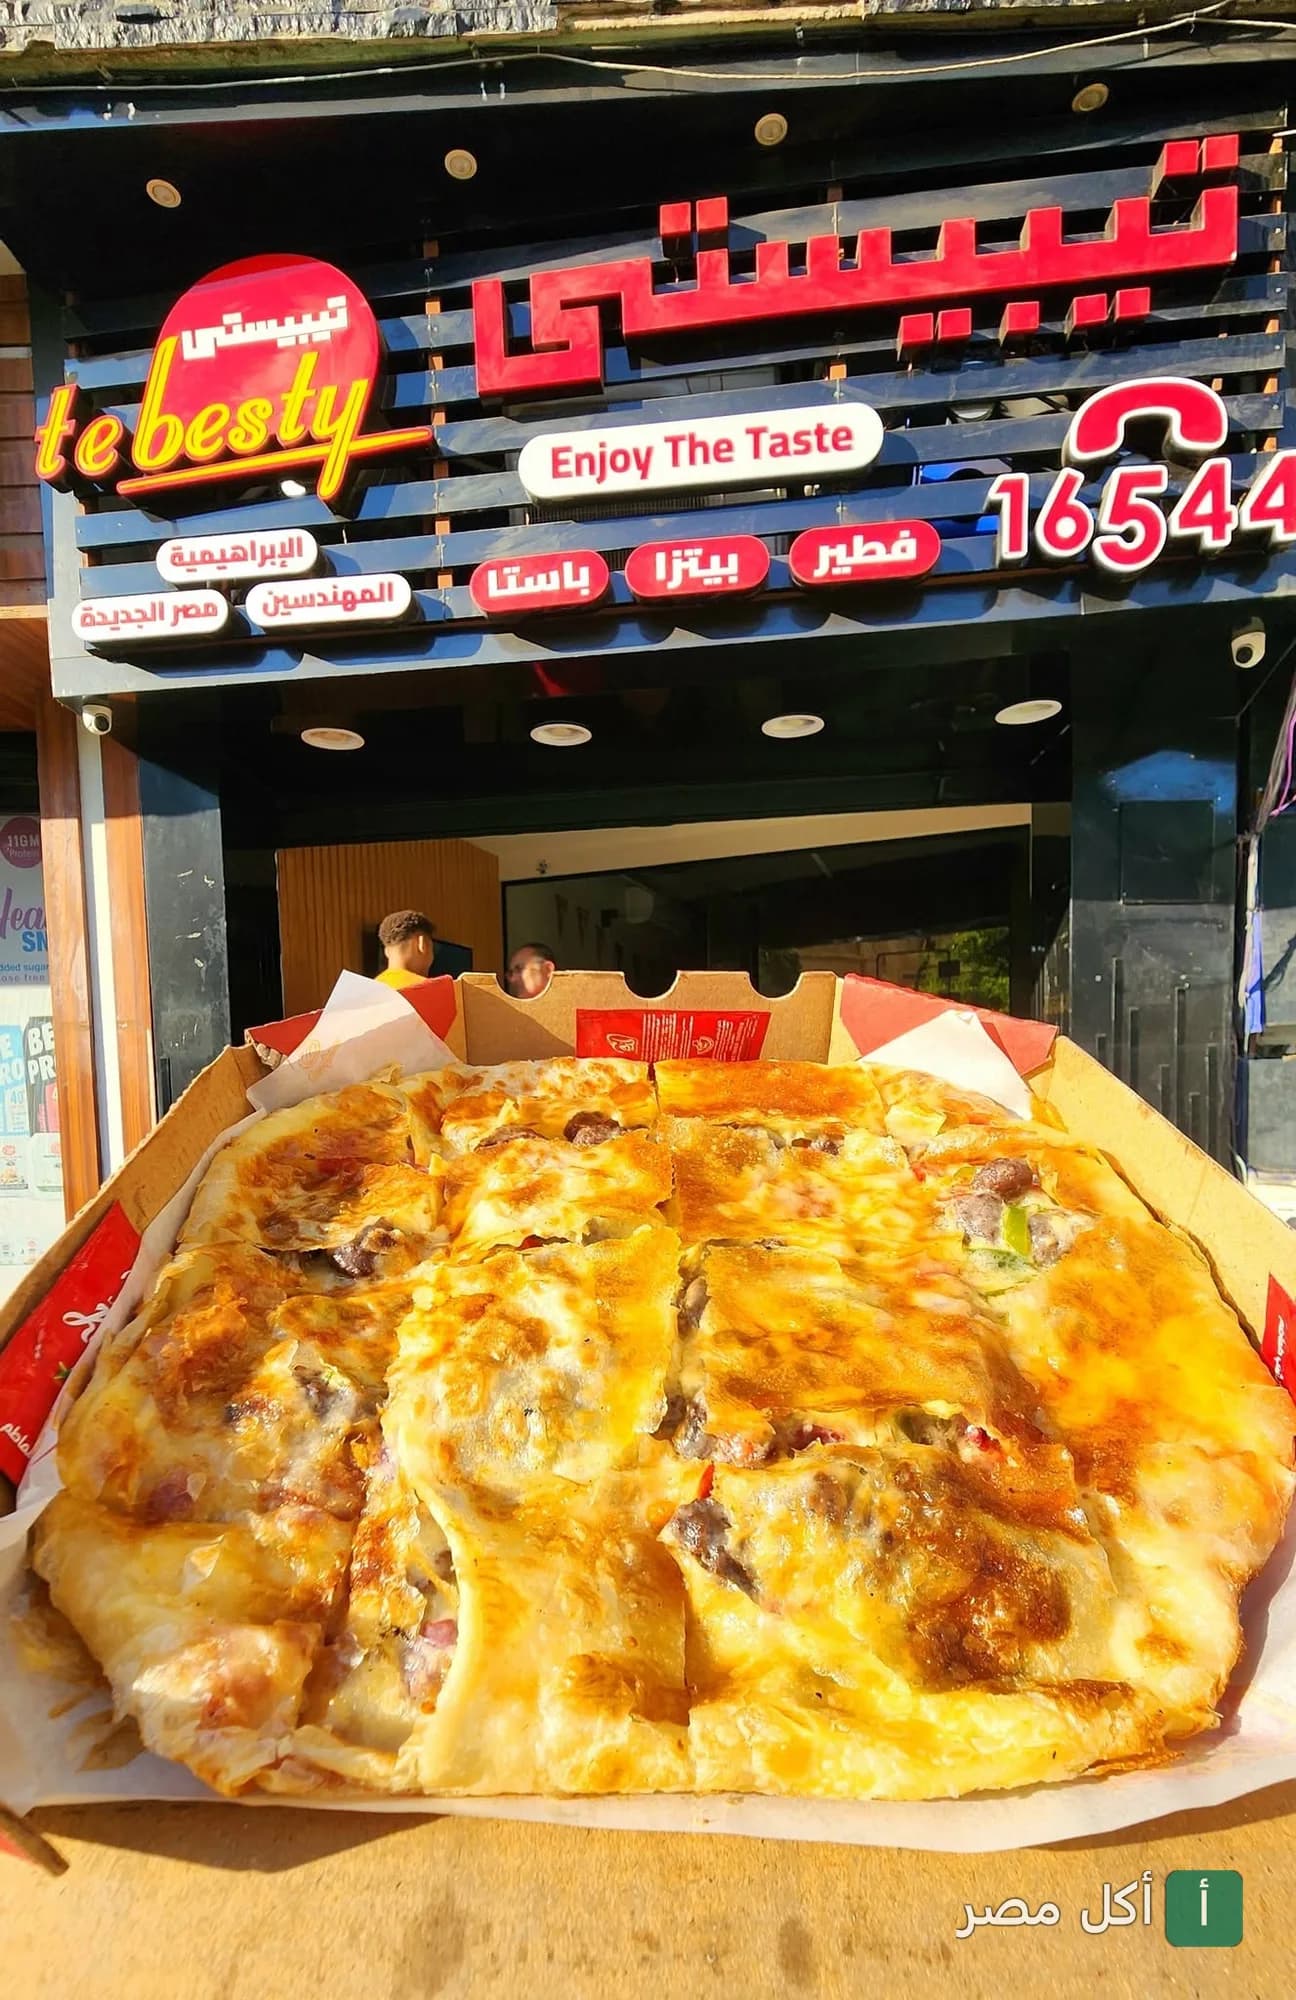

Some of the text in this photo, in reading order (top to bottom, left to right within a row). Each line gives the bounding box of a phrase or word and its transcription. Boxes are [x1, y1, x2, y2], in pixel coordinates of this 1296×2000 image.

[35, 335, 370, 498] tebesty
[550, 421, 854, 484] Enjoy The Taste
[988, 450, 1296, 572] 16544
[170, 537, 303, 573] الإبراهيمية
[654, 547, 740, 590] بيتزا
[813, 530, 918, 577] فطير
[262, 582, 394, 617] المهندسين
[487, 561, 591, 598] باستا
[80, 601, 219, 631] مصر الجديدة
[27, 1055, 57, 1084] PR
